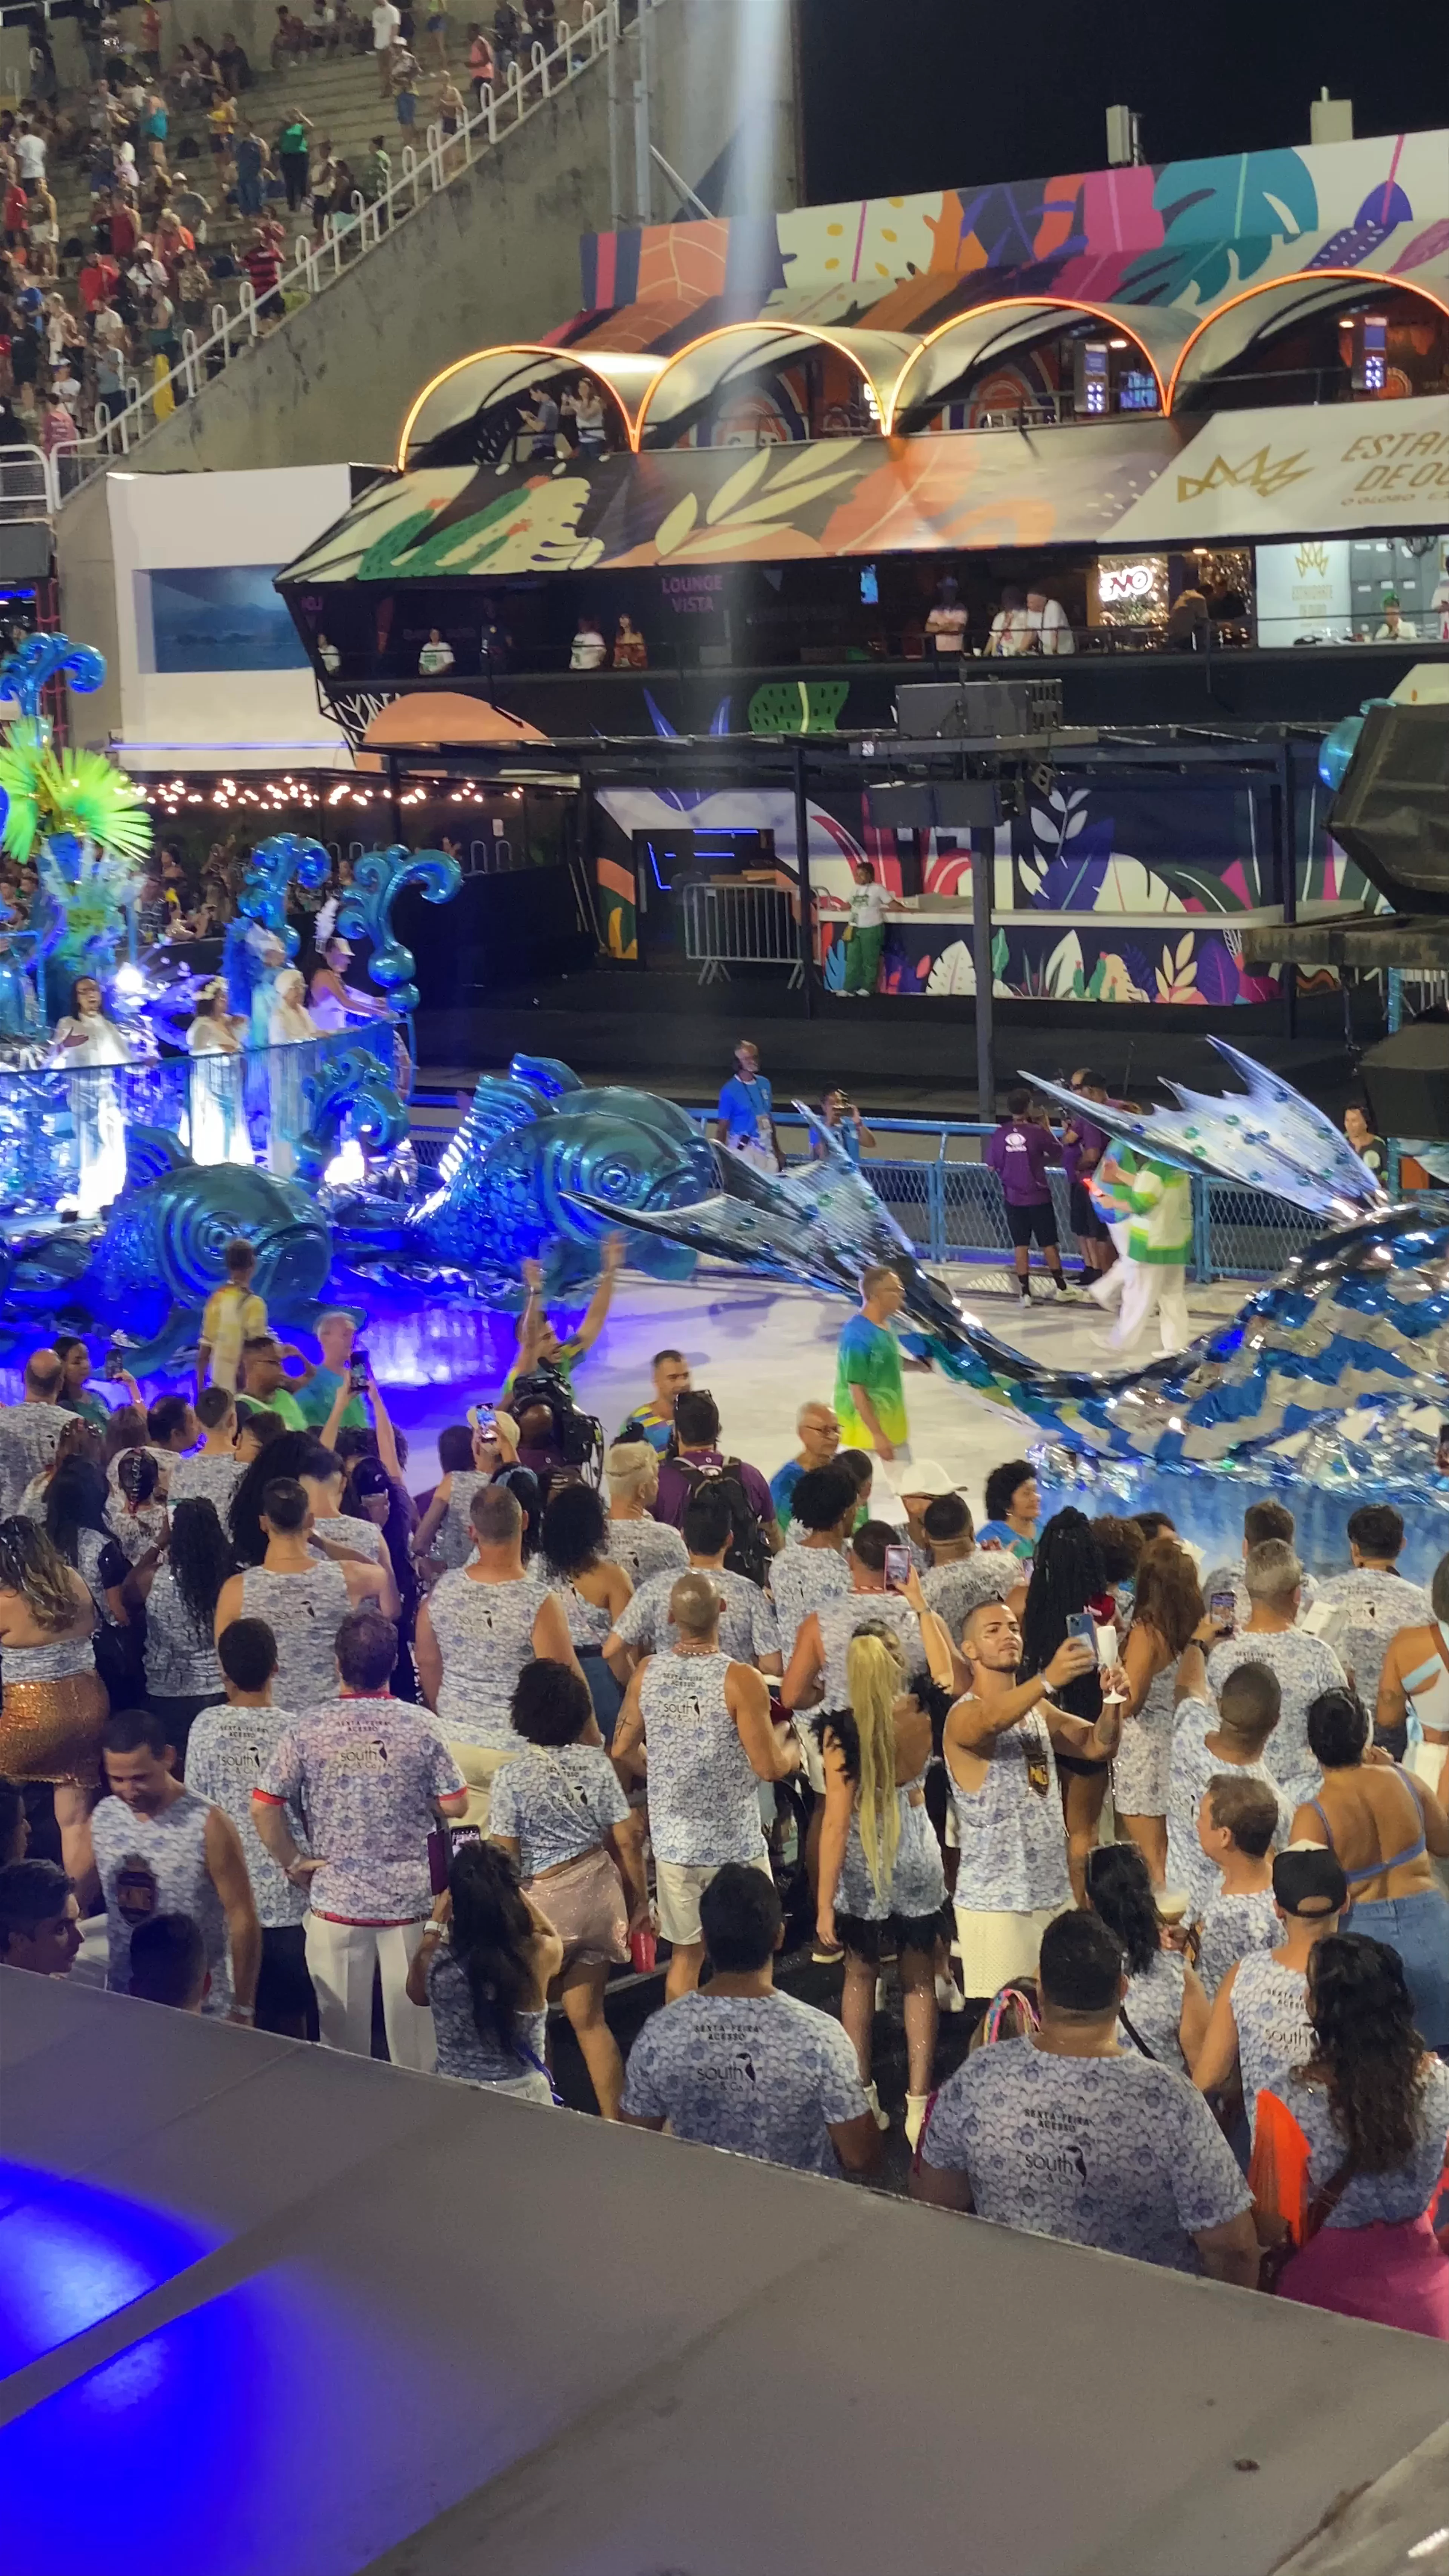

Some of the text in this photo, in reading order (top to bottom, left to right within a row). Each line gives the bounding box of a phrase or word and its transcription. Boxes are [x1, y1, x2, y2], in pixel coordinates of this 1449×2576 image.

[1353, 464, 1414, 491] DE
[662, 575, 723, 594] LOUNGE
[672, 595, 714, 612] VISTA
[340, 1746, 377, 1761] south
[1266, 2029, 1307, 2047] south
[697, 2061, 743, 2081] south
[1038, 2121, 1076, 2133] ACESSO
[1025, 2153, 1073, 2175] south
